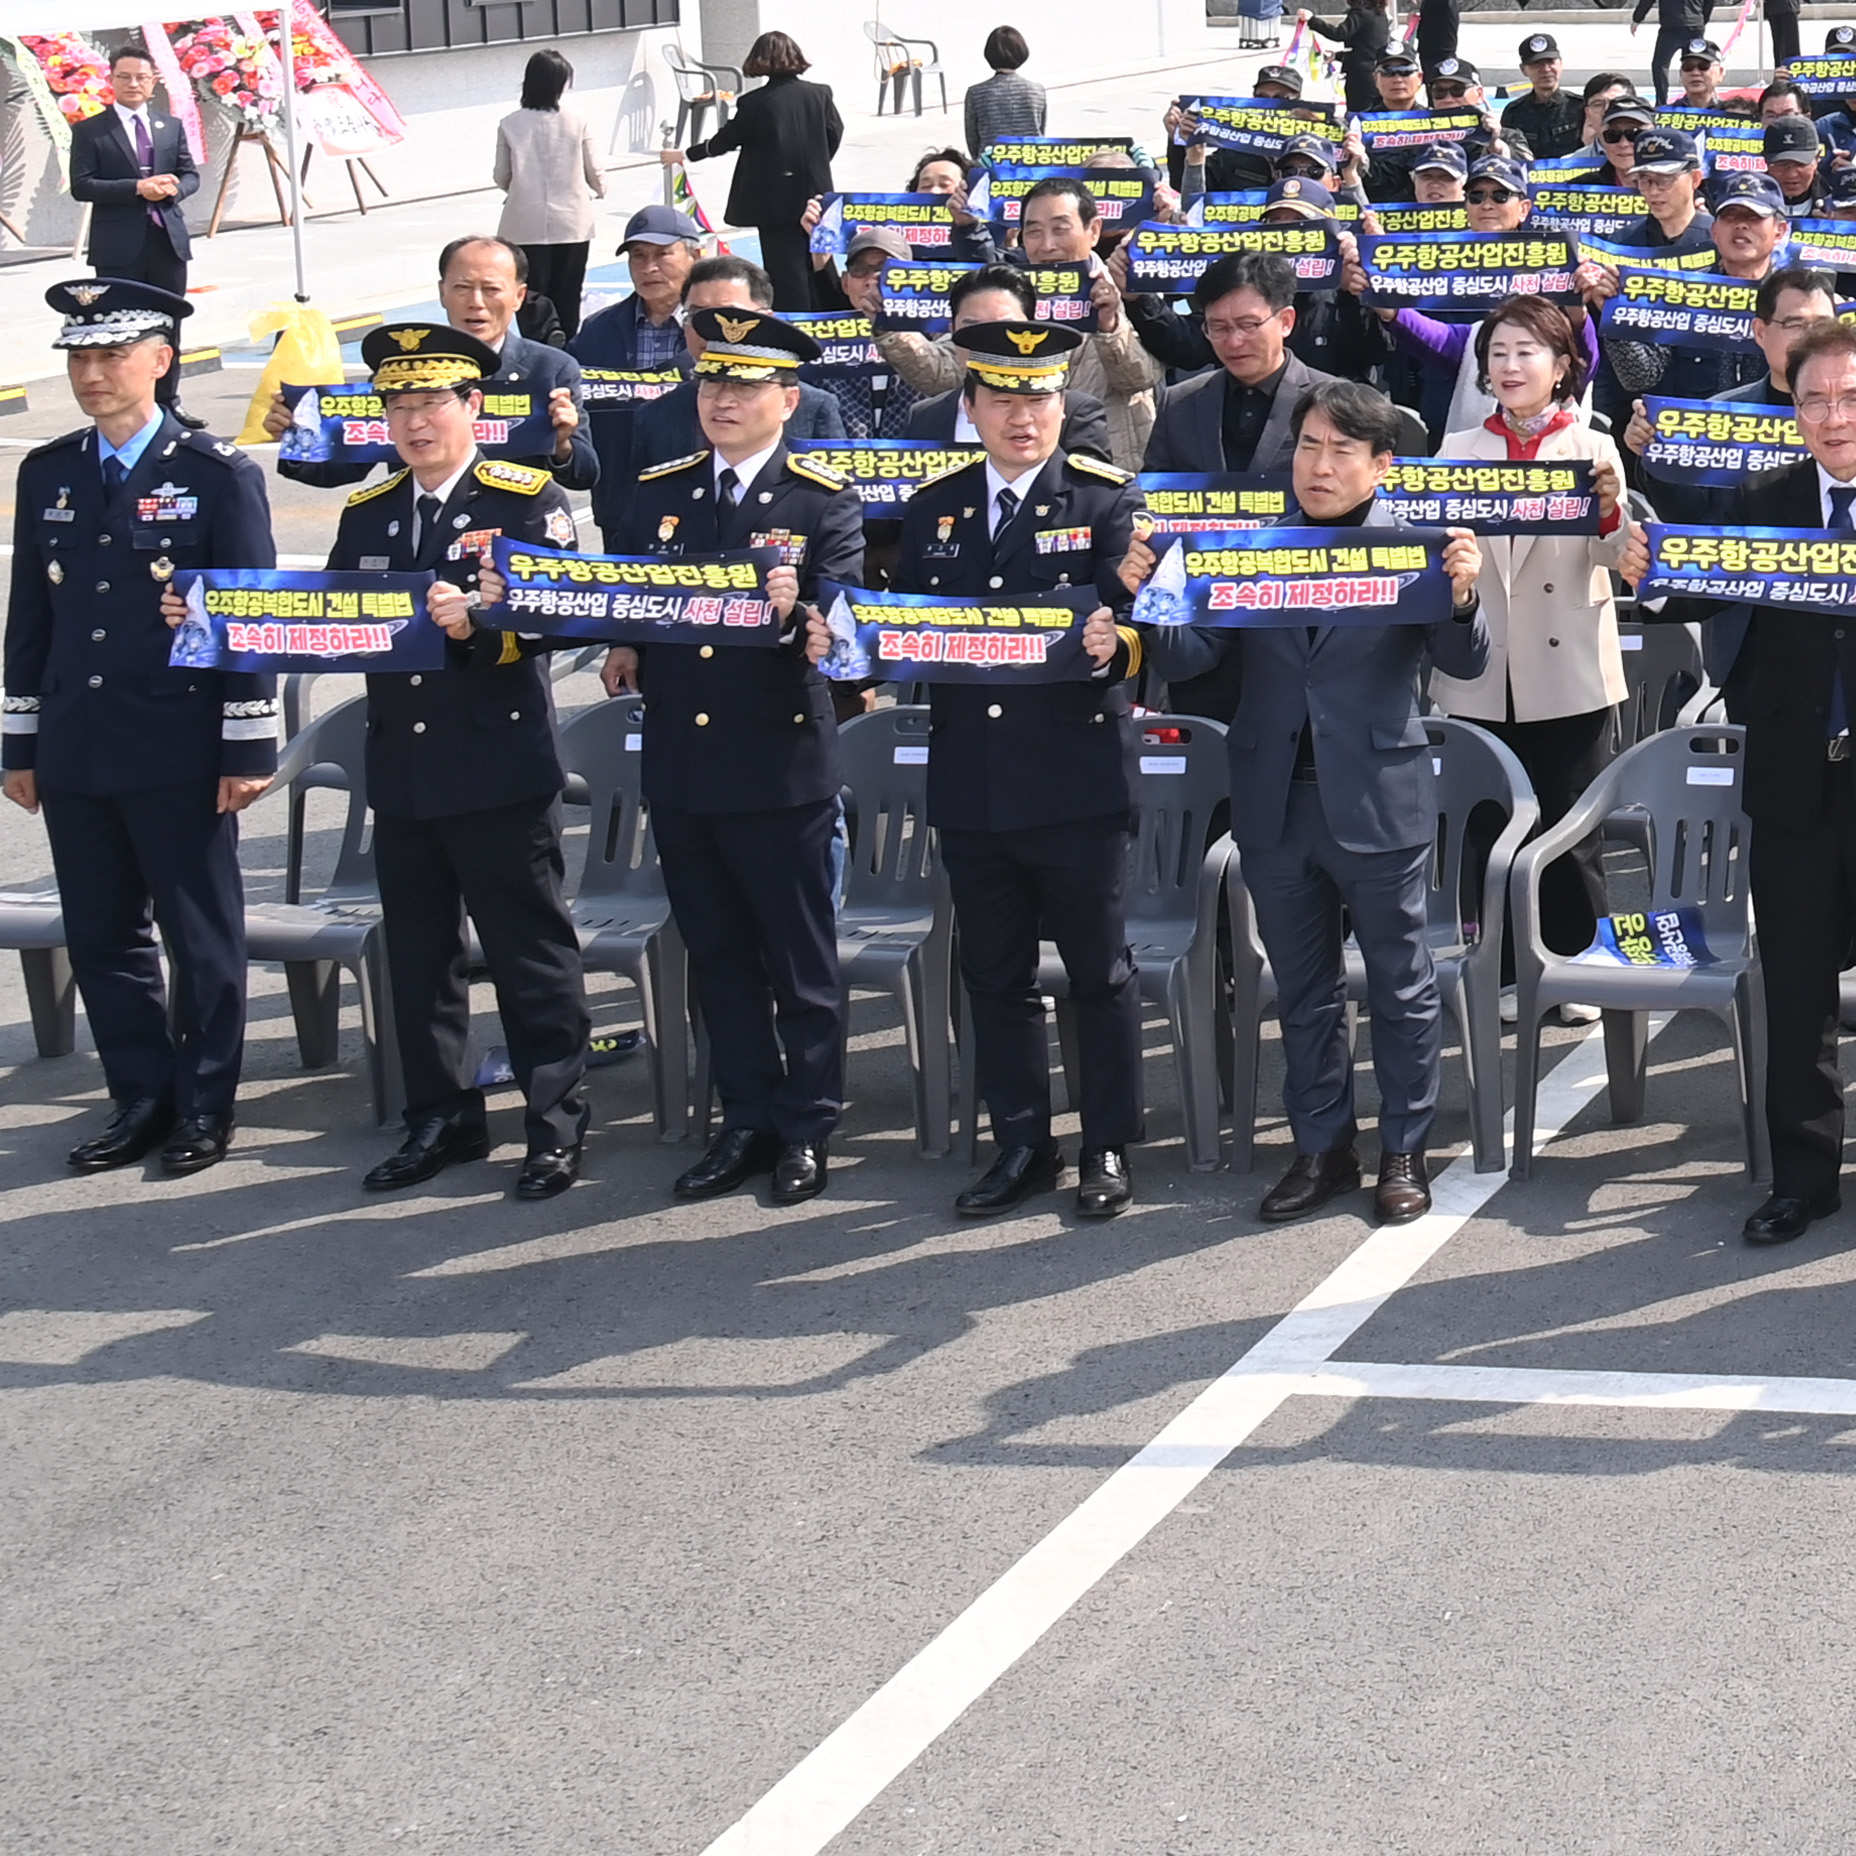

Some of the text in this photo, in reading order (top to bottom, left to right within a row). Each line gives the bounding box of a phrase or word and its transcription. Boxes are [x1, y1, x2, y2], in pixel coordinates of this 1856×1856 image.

[1201, 106, 1345, 142] 우주항공산업진흥원
[1715, 154, 1753, 172] 조속히
[843, 204, 931, 222] 우주항공복합도시
[1139, 230, 1326, 254] 우주항공산업진흥원
[1375, 241, 1568, 270] 우주항공산업진흥원
[1133, 259, 1208, 279] 우주항공산업
[1370, 275, 1540, 295] 우주항공산업 중심도시 사천
[1612, 307, 1754, 339] 우주항공산업 중심도시
[484, 395, 531, 416] 특별법
[1646, 443, 1743, 470] 우주항공산업
[1206, 491, 1285, 514] 건설 특별법
[1445, 497, 1589, 521] 중심도시 사천 설립!
[511, 554, 758, 589] 우주항공산업진흥원
[1186, 545, 1427, 576] 우주항공복합도시 건설 특별법
[206, 590, 415, 618] 우주항공복합도시 건설 특별법
[1208, 576, 1399, 610] 조속히 제정하라!!
[1769, 581, 1848, 604] 중심도시
[507, 588, 773, 627] 우주항공산업 중심도시 사천 설립!
[852, 604, 985, 626] 우주항공복합도시
[226, 623, 393, 656] 조속히 제정하라!!
[878, 630, 1049, 665] 조속히 제정하라!!
